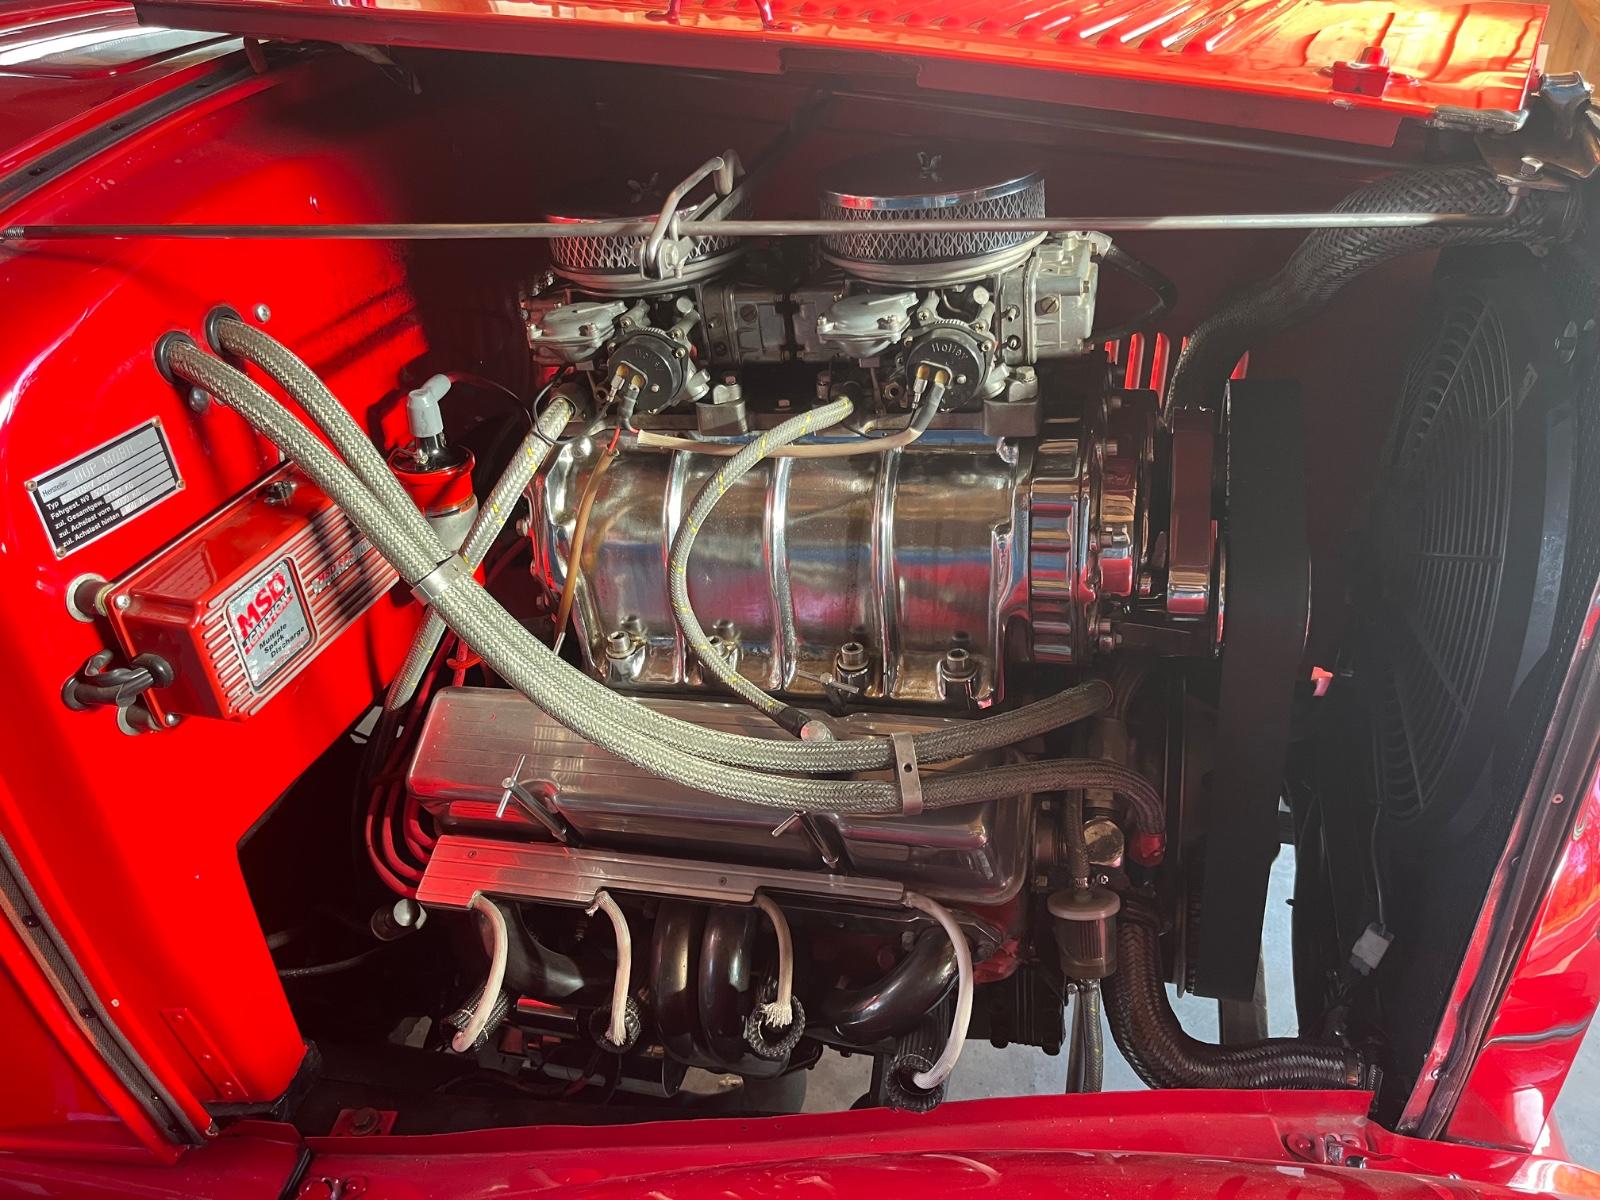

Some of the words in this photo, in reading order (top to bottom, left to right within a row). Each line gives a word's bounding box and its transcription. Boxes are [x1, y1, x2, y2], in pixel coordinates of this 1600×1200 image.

[46, 501, 60, 511] Typ
[54, 519, 67, 529] zul.
[59, 529, 71, 539] zul.
[71, 513, 98, 532] Achslast
[98, 506, 112, 517] vorn
[62, 537, 75, 548] zul.
[74, 522, 101, 542] Achslast
[101, 512, 121, 526] hinten
[236, 571, 287, 638] MSD
[258, 623, 287, 650] Multiple
[263, 634, 285, 655] Spark
[270, 625, 305, 659] Discharge
